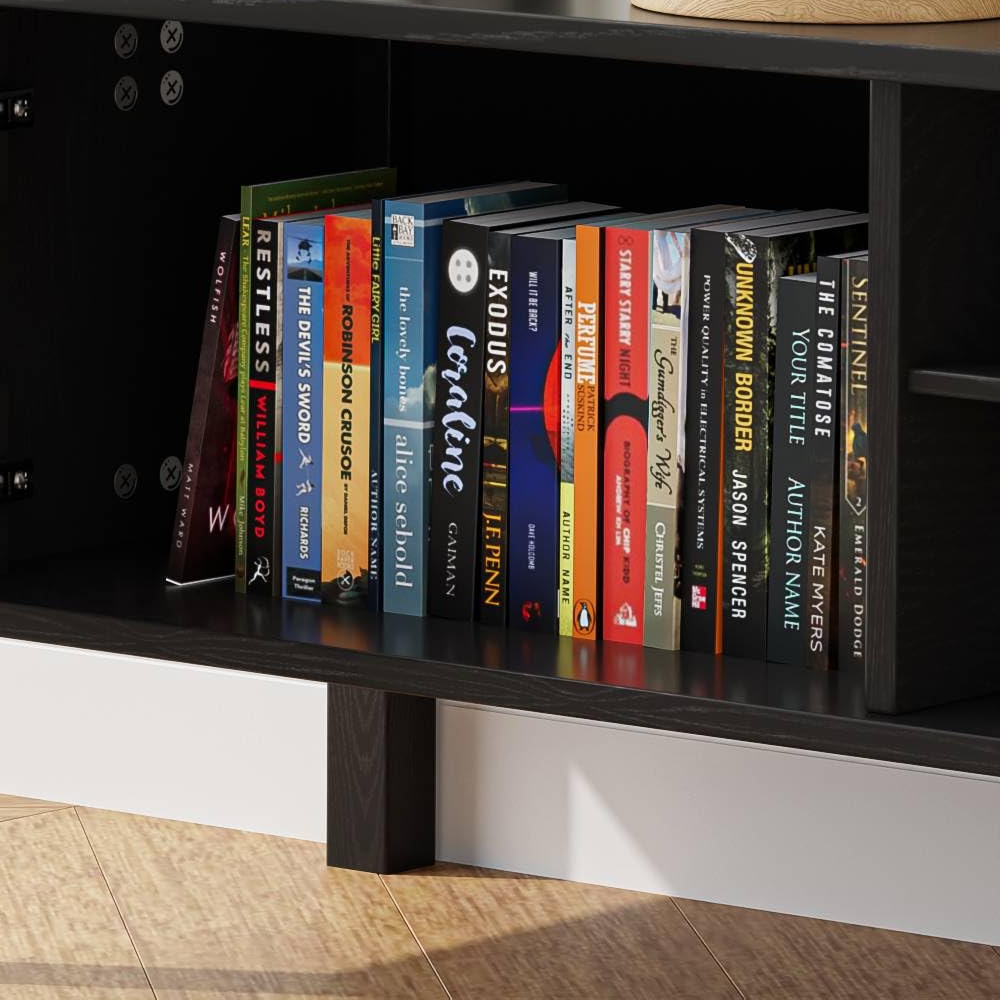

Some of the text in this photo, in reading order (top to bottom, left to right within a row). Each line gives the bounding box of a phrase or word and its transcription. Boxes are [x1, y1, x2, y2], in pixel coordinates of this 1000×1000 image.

[241, 216, 250, 246] LEAR
[528, 271, 538, 288] WILL
[209, 251, 227, 324] WOLFISH
[254, 229, 272, 373] RESTLESS
[371, 236, 380, 344] Little FAIRY GIRL
[487, 268, 508, 374] EXODUS
[528, 298, 538, 306] BE
[528, 308, 538, 332] BACK?
[564, 286, 573, 325] AFTER
[618, 249, 632, 388] STARRY STARRY NIGHT
[851, 276, 868, 394] SENTINEL
[298, 286, 312, 444] THE DEVIL'S SWORD
[340, 304, 353, 481] ROBINSON CRUSOE
[396, 286, 411, 413] the lovely bones
[564, 354, 572, 380] END
[576, 300, 596, 385] PERFUME
[670, 336, 678, 356] THE
[735, 262, 754, 453] UNKNOWN BORDER
[789, 328, 810, 446] YOUR TITLE
[814, 280, 836, 439] THE COMATOSE
[440, 325, 477, 497] Coraline
[587, 386, 596, 432] PATRICK
[650, 348, 676, 495] Gumdigger's Wife
[696, 274, 711, 550] POWER QUALITY in ELECTRICAL SYSTEMS
[176, 463, 194, 549] MATT WARD
[209, 504, 237, 534] W
[254, 395, 268, 538] WILLIAM BOYD
[395, 434, 414, 588] alice sebold
[623, 440, 631, 505] BIOGRAPHY
[623, 510, 630, 525] OF
[237, 495, 246, 556] Mike Johnson
[300, 506, 308, 560] RICHARDS
[370, 471, 378, 580] AUTHOR NAME
[445, 522, 458, 597] GAIMAN
[484, 544, 500, 606] PENN
[562, 511, 570, 604] AUTHOR NAME
[622, 556, 630, 584] KIDD
[731, 469, 747, 619] JASON SPENCER
[784, 476, 806, 631] AUTHOR NAME
[810, 524, 826, 652] KATE MYERS
[854, 524, 866, 658] EMERALD DODGE
